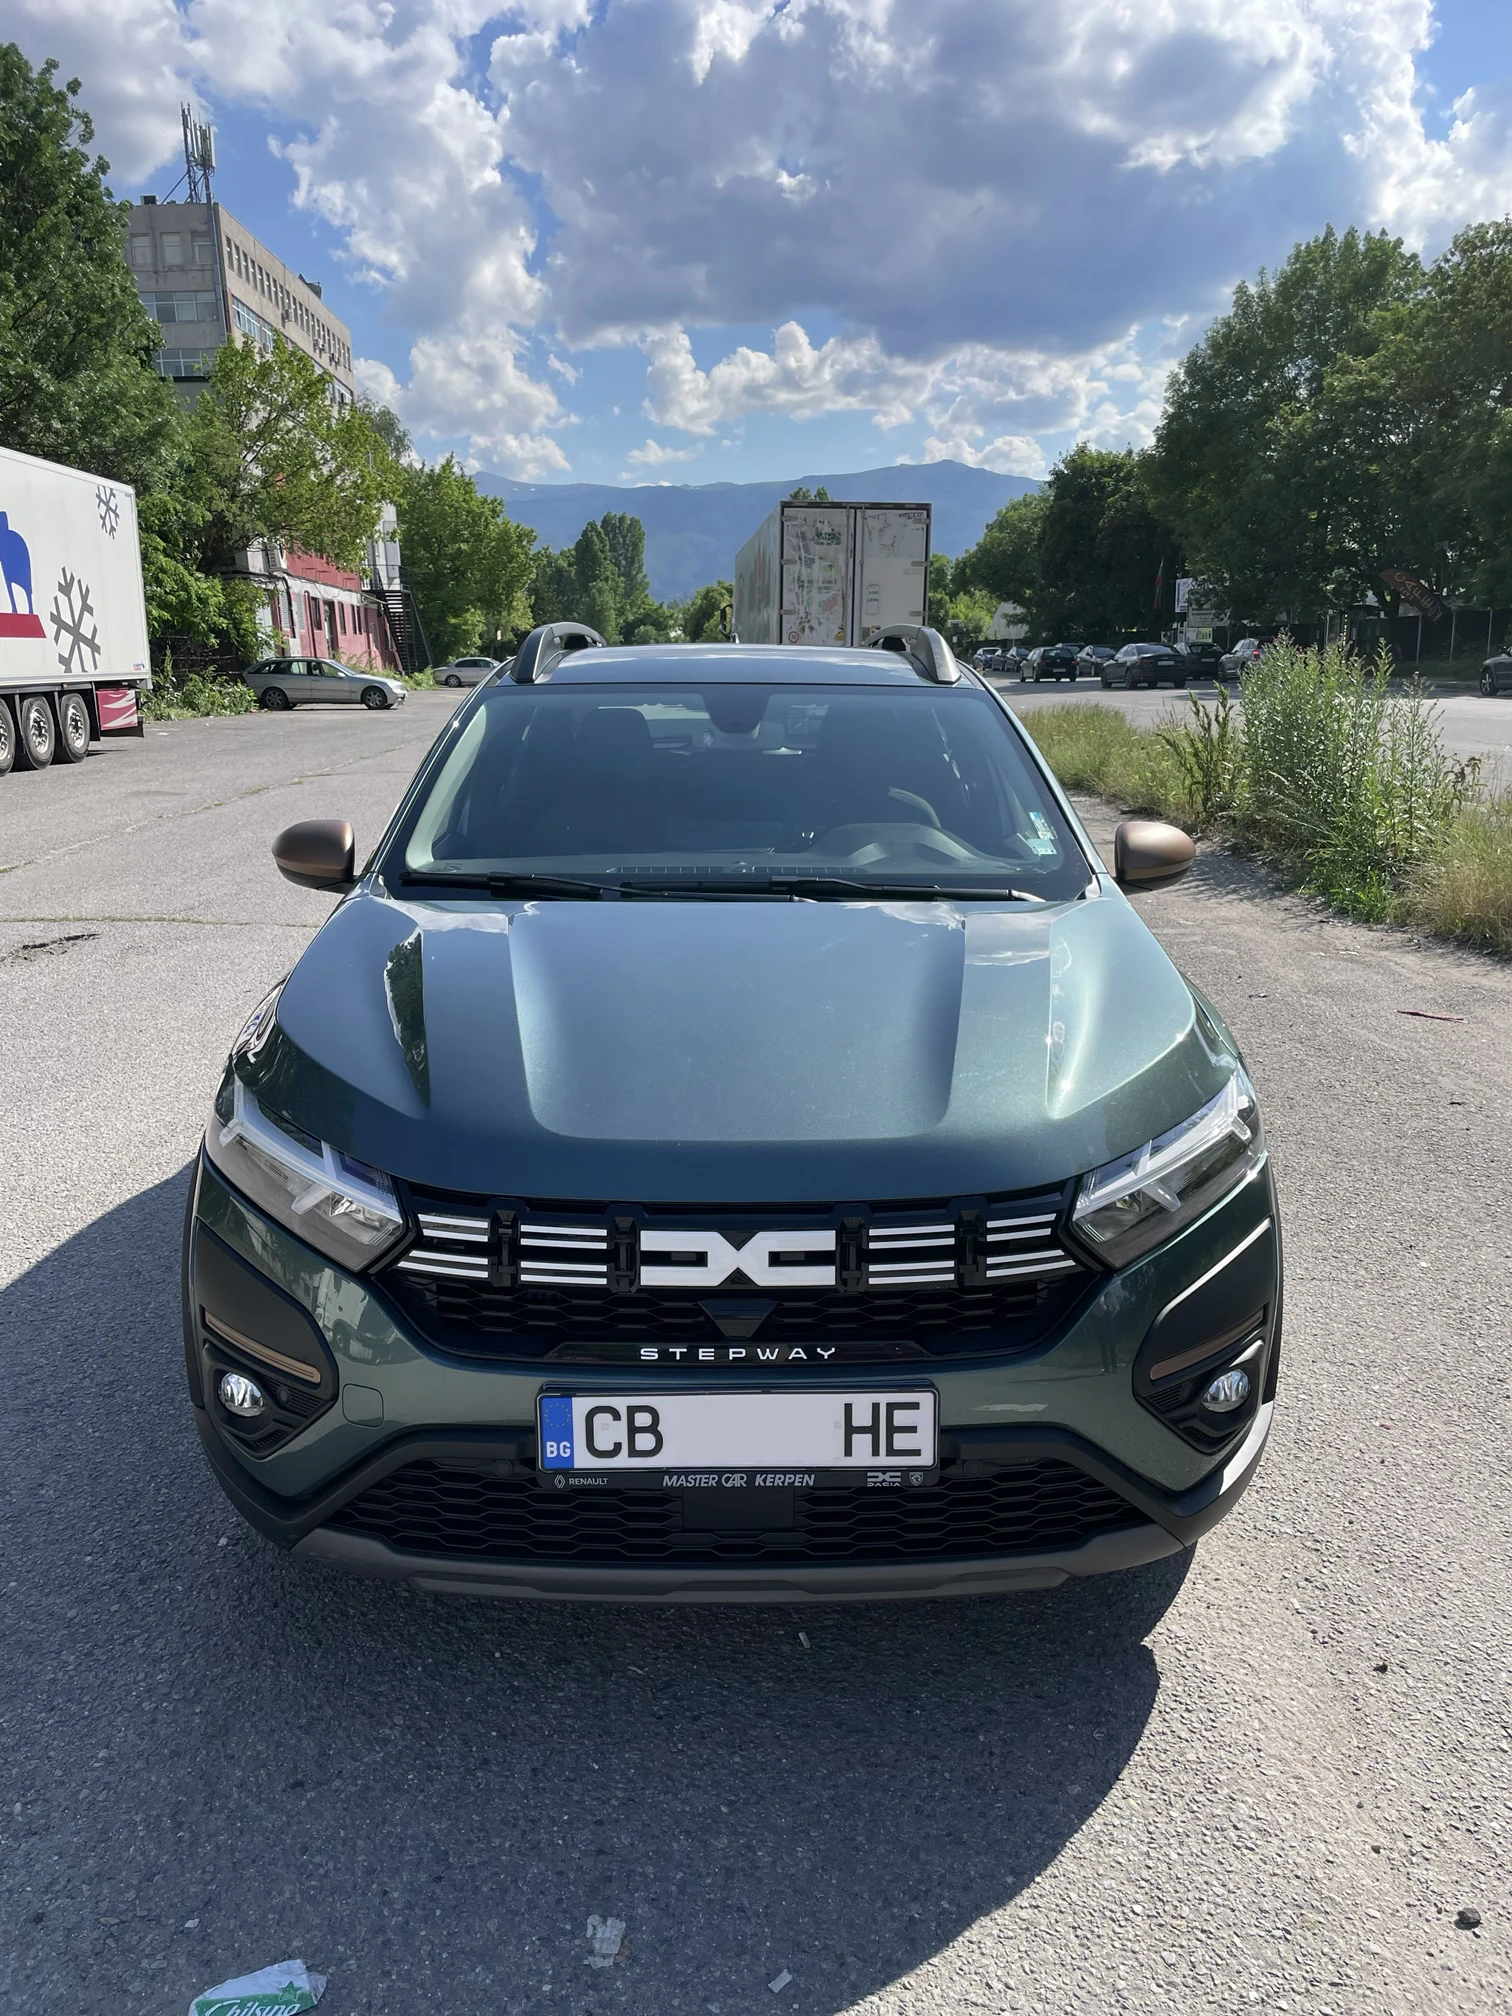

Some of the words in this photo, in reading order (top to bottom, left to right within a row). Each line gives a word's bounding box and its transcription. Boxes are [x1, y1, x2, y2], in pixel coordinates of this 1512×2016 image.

[640, 1347, 836, 1360] STEPWAY
[585, 1405, 664, 1459] CB
[844, 1402, 922, 1457] HE
[546, 1441, 571, 1458] BG
[663, 1475, 719, 1487] MASTER
[721, 1473, 748, 1487] CAR
[755, 1473, 816, 1486] KERPEN
